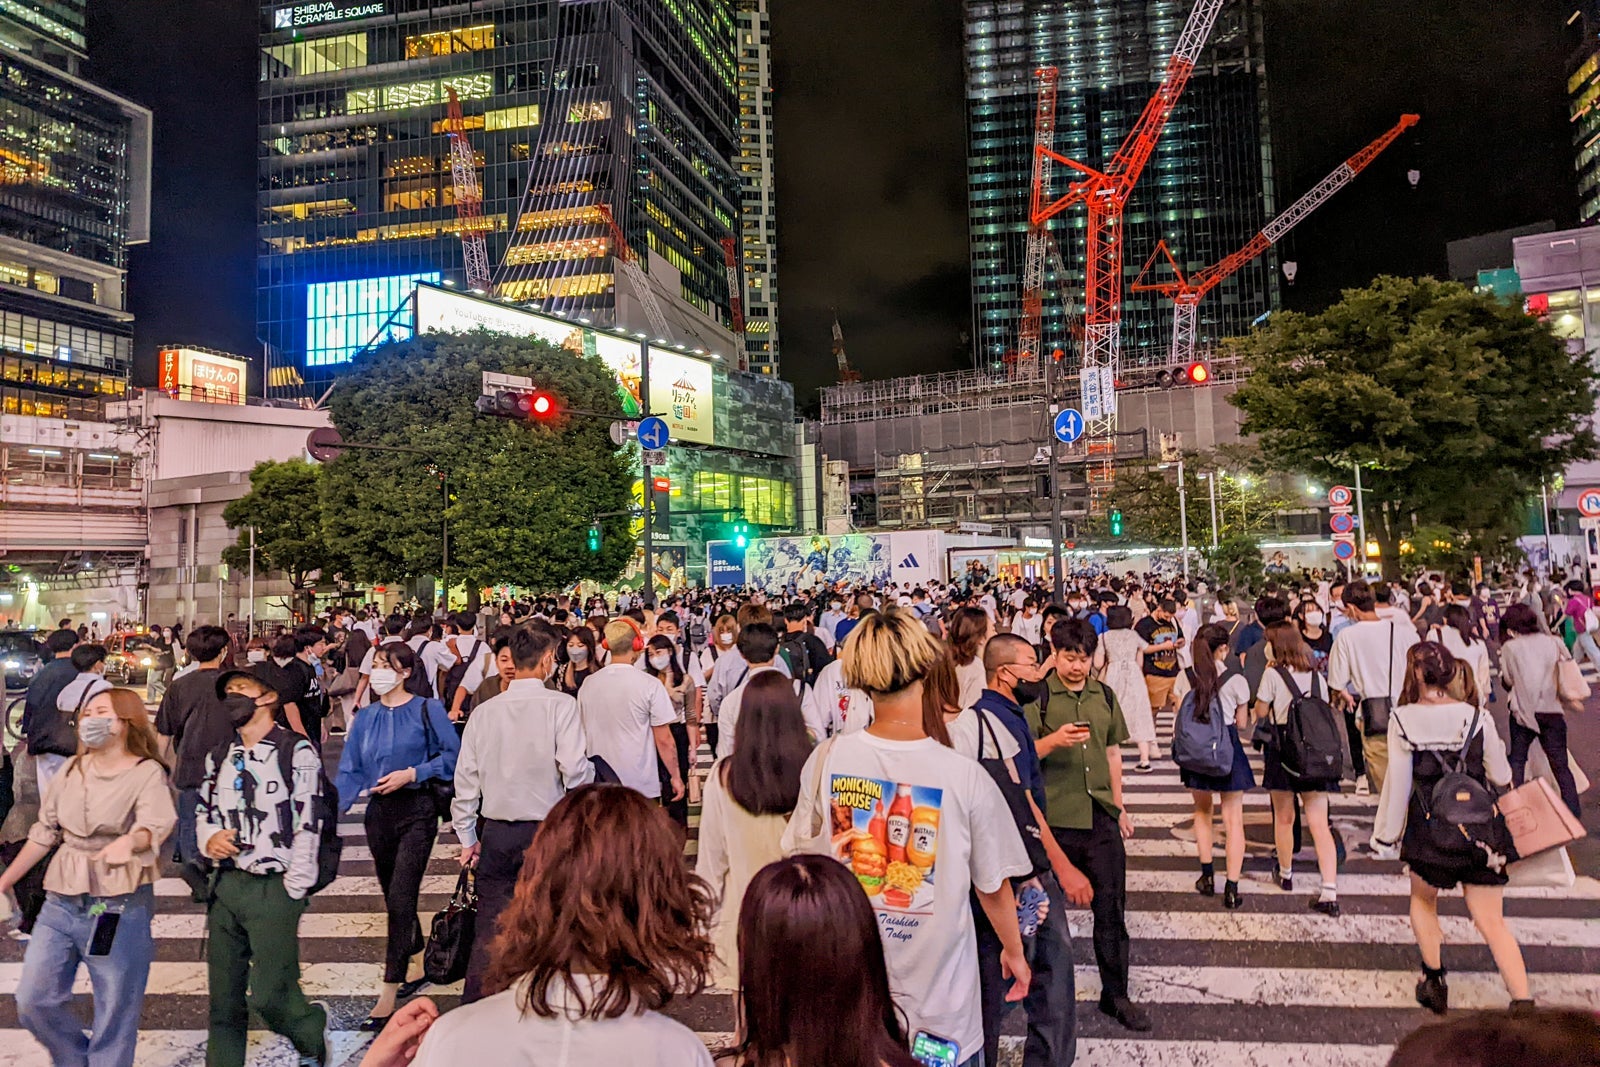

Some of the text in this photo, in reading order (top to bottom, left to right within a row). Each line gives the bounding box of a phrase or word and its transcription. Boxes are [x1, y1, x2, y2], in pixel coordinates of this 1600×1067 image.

[294, 2, 334, 16] SHIBUYA
[294, 3, 384, 25] SCRAMBLE SQUARE
[193, 363, 239, 384] ほけんの
[1088, 371, 1098, 416] 渋谷駅前
[832, 777, 882, 799] MONICHIKI
[839, 792, 872, 810] HOUSE
[879, 913, 919, 928] Taishido
[885, 927, 913, 942] Tokyo
